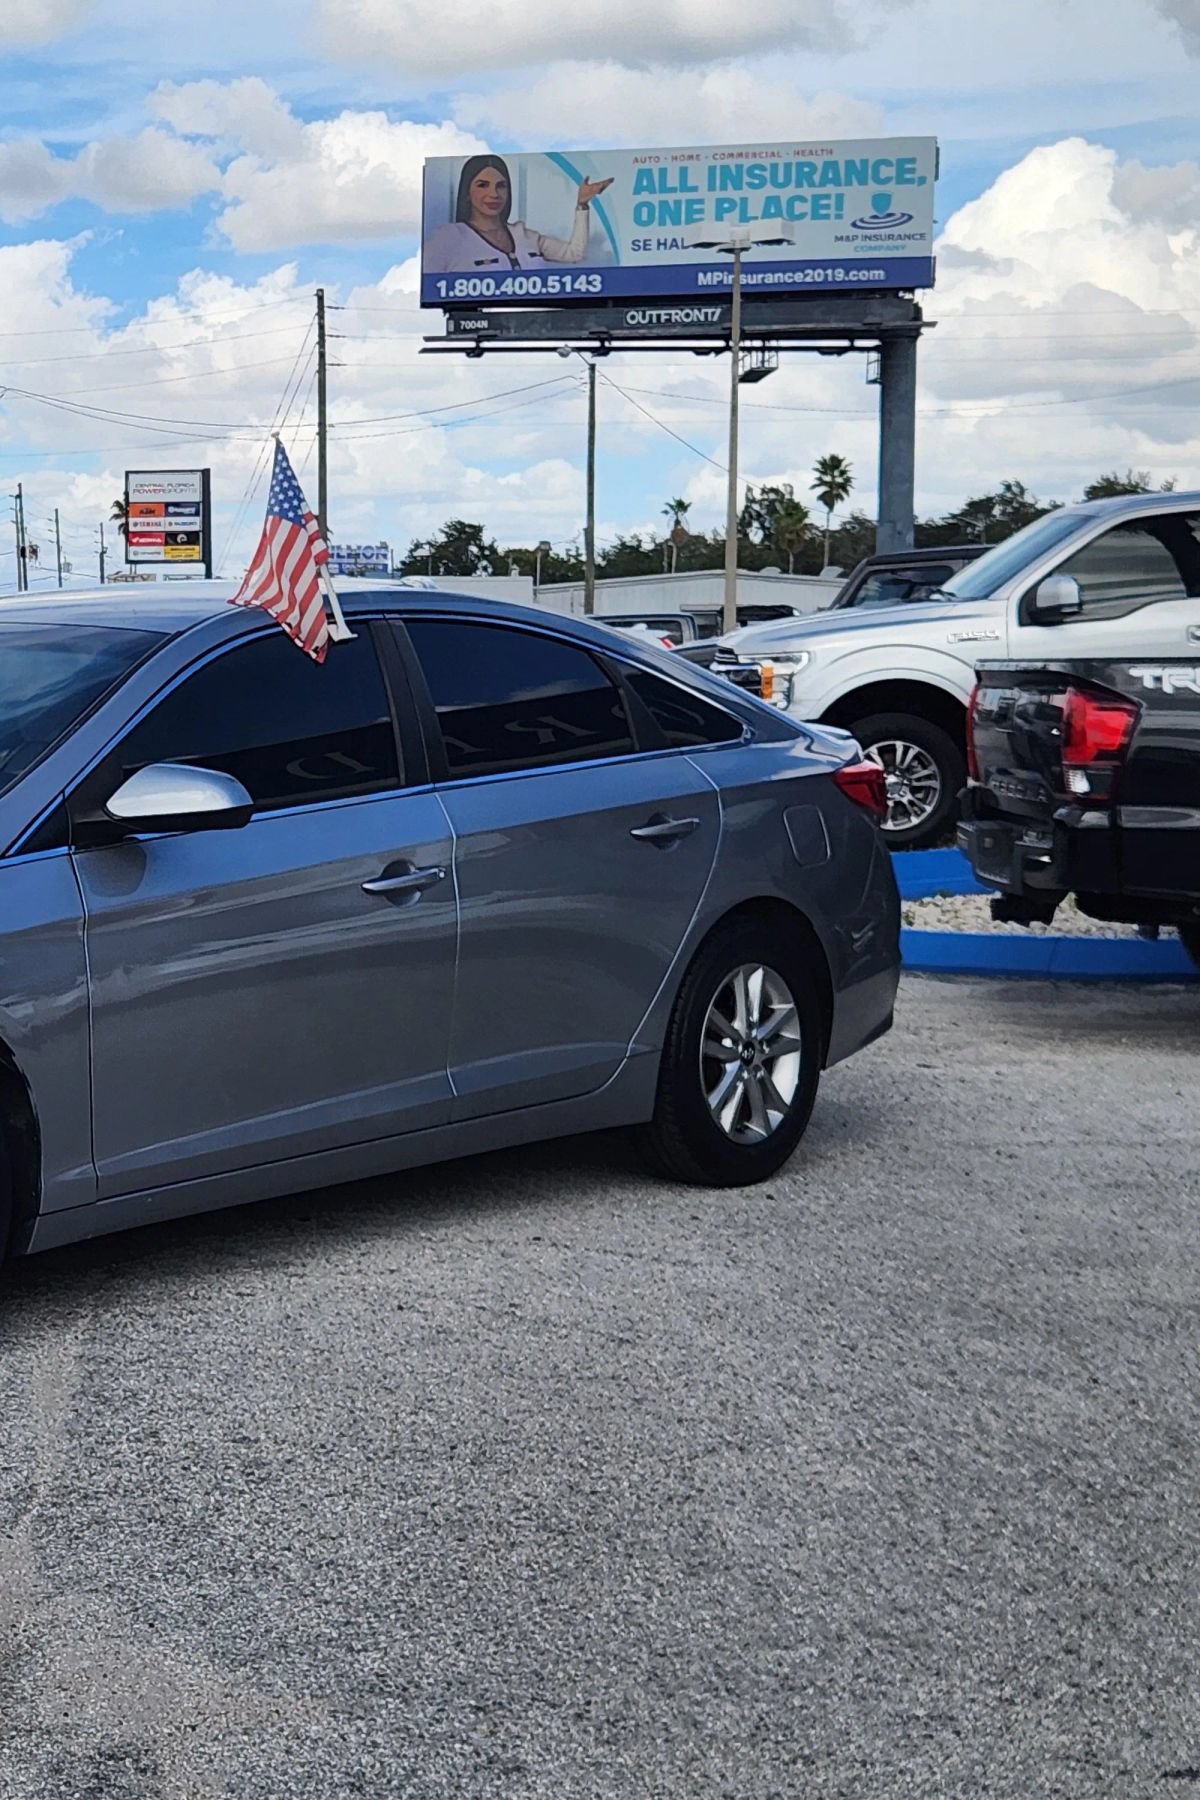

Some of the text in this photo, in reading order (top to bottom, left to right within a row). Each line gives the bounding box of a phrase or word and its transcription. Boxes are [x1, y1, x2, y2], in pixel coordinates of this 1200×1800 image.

[632, 148, 834, 164] AUTO HOME COMMERCIAL HEALTH
[632, 157, 927, 195] ALL INSURANCE,
[633, 193, 845, 227] ONE PLACE!
[631, 239, 652, 251] SE
[834, 232, 927, 243] M&P INSURANCE
[853, 244, 907, 253] COMPANY
[436, 274, 602, 298] 1.800.400.5143
[460, 320, 488, 330] 7004N
[329, 545, 388, 559] ILLION
[1128, 667, 1200, 694] TR
